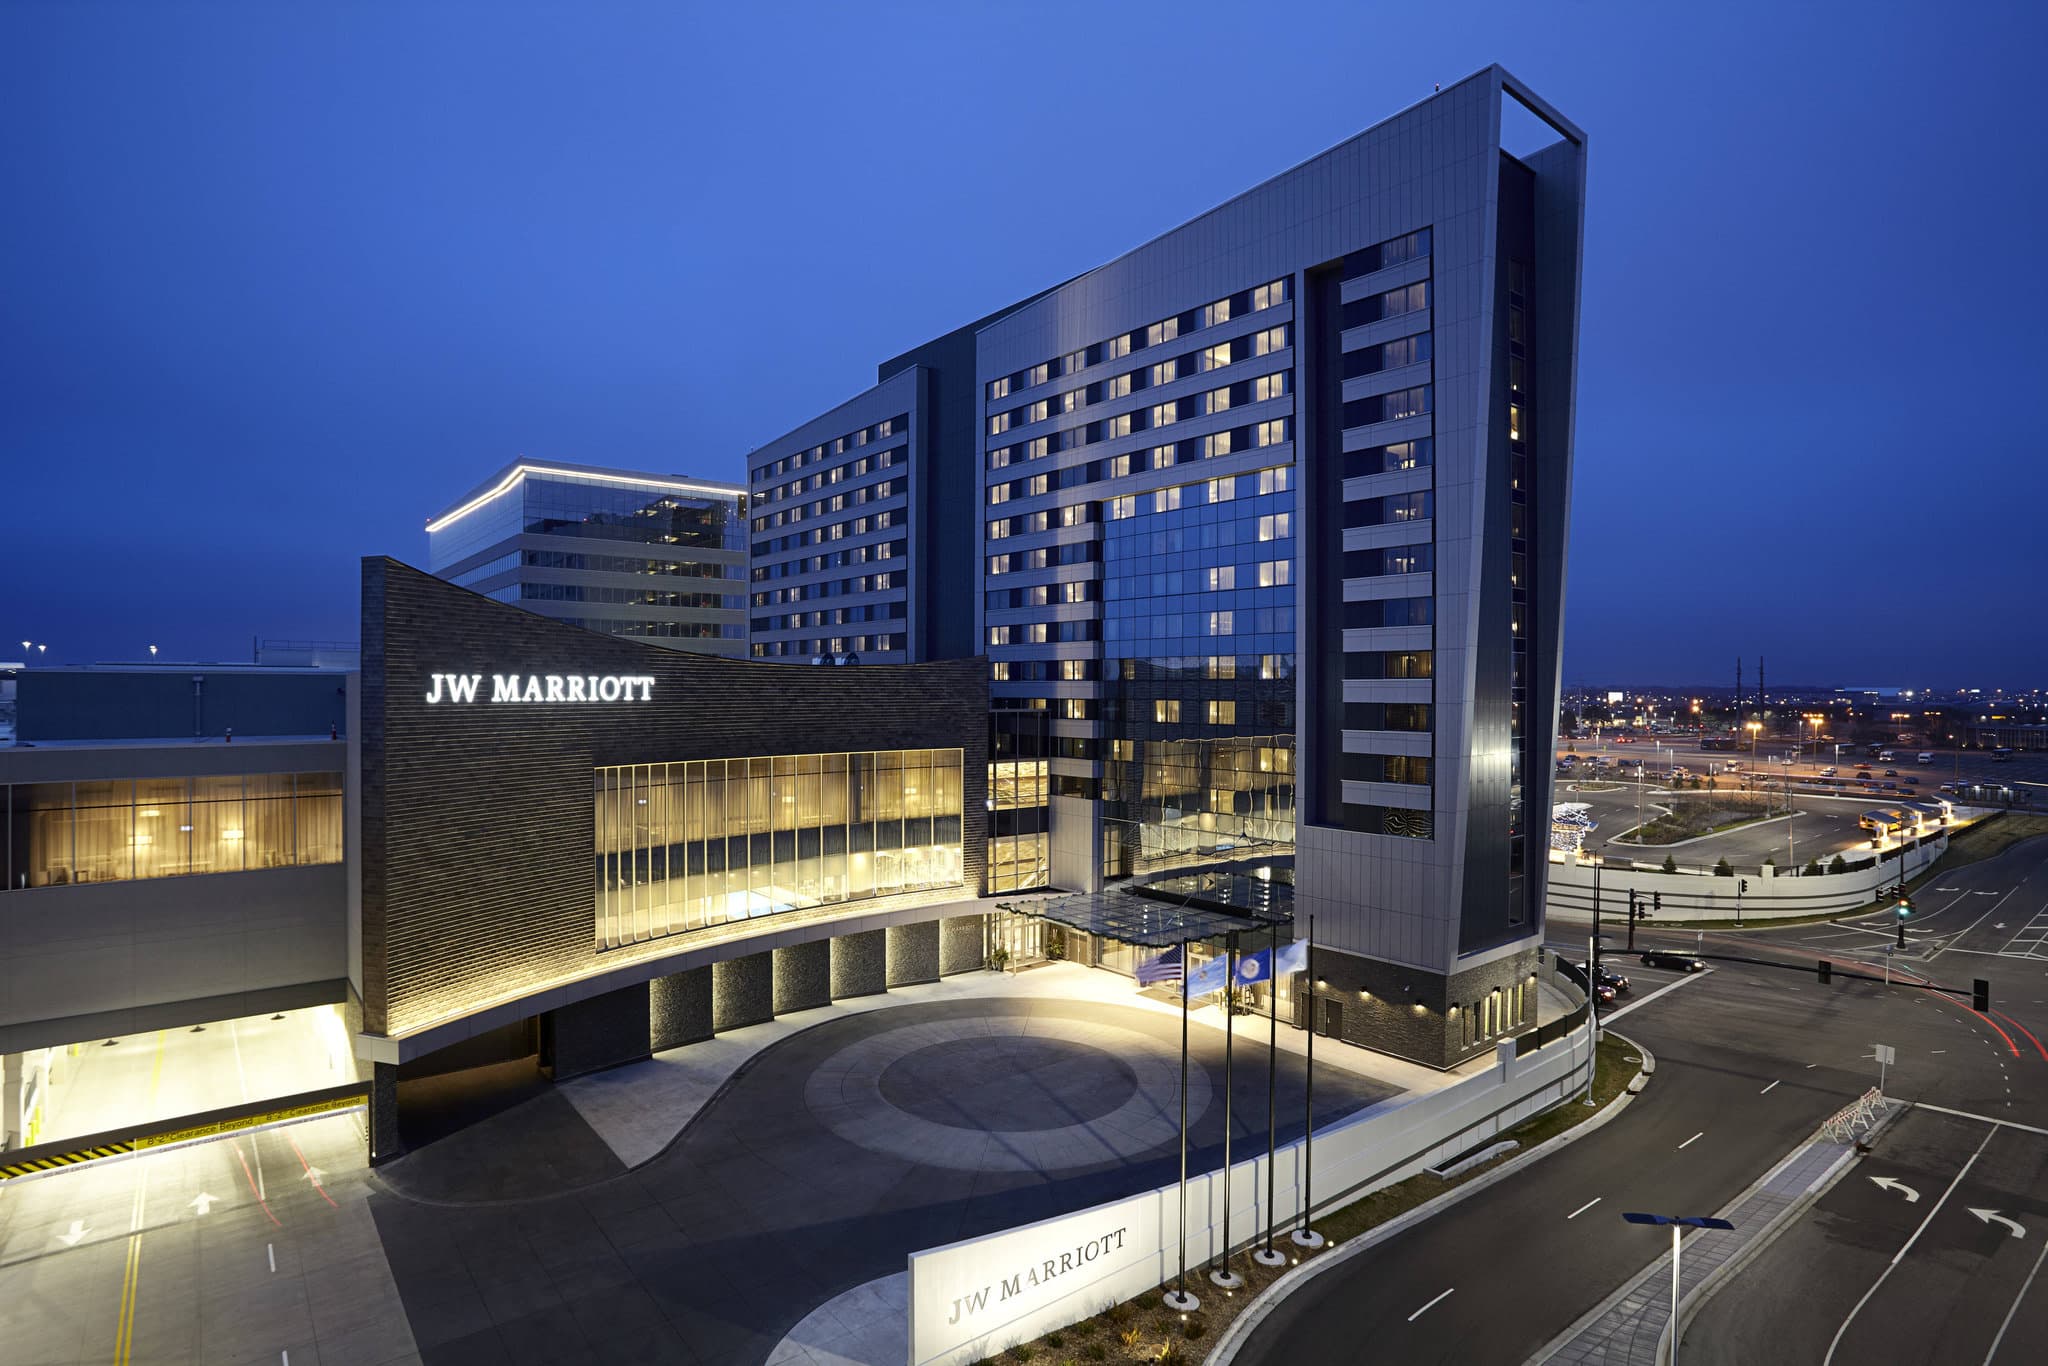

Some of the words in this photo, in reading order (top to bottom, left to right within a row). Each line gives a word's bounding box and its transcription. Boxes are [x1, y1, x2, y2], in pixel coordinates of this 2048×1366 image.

[426, 674, 482, 703] JW
[491, 674, 655, 702] MARRIOTT
[170, 1126, 216, 1141] Clearance
[219, 1118, 253, 1132] Beyond
[949, 1287, 991, 1325] JW
[1000, 1228, 1126, 1302] MARRIOTT
